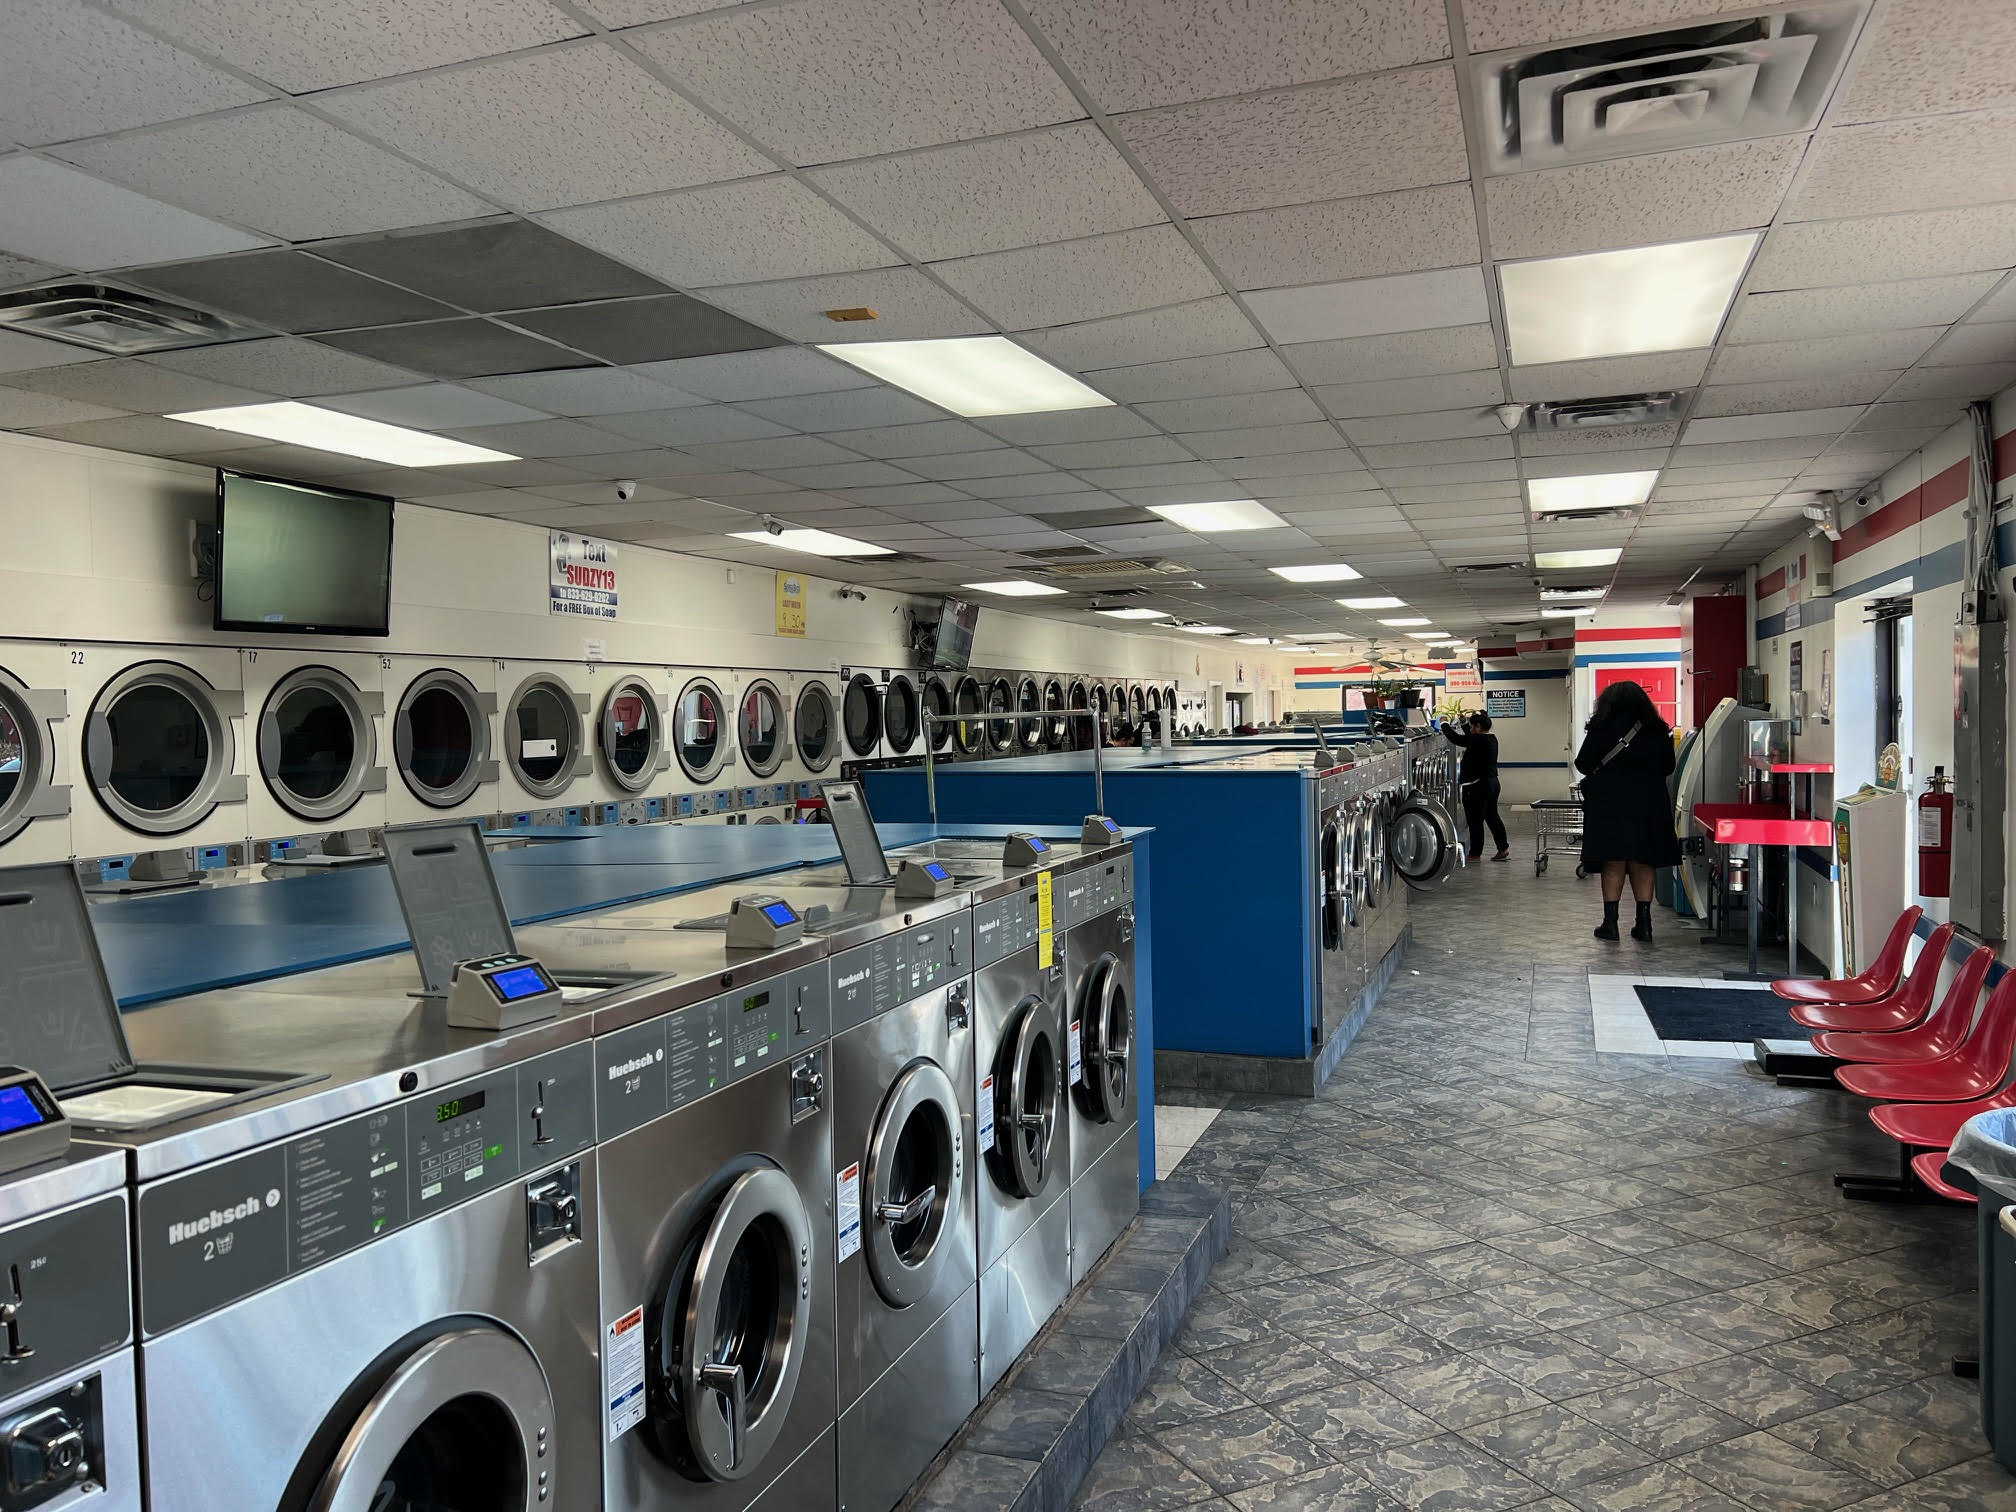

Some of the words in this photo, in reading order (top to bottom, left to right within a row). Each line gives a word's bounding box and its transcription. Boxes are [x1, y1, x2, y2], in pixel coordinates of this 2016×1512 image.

[582, 540, 606, 563] Text
[566, 564, 615, 591] SUDZY13
[553, 600, 563, 612] For
[568, 602, 582, 615] FREE
[582, 604, 594, 616] Box
[594, 605, 601, 616] of
[601, 606, 617, 619] Soap
[71, 651, 84, 665] 22
[249, 651, 258, 664] 17
[382, 658, 391, 670] 52
[1492, 690, 1520, 698] NOTICE
[608, 1052, 654, 1081] Huebsch
[624, 1080, 632, 1094] 2
[168, 1196, 261, 1246] Huebsch
[203, 1241, 215, 1262] 2
